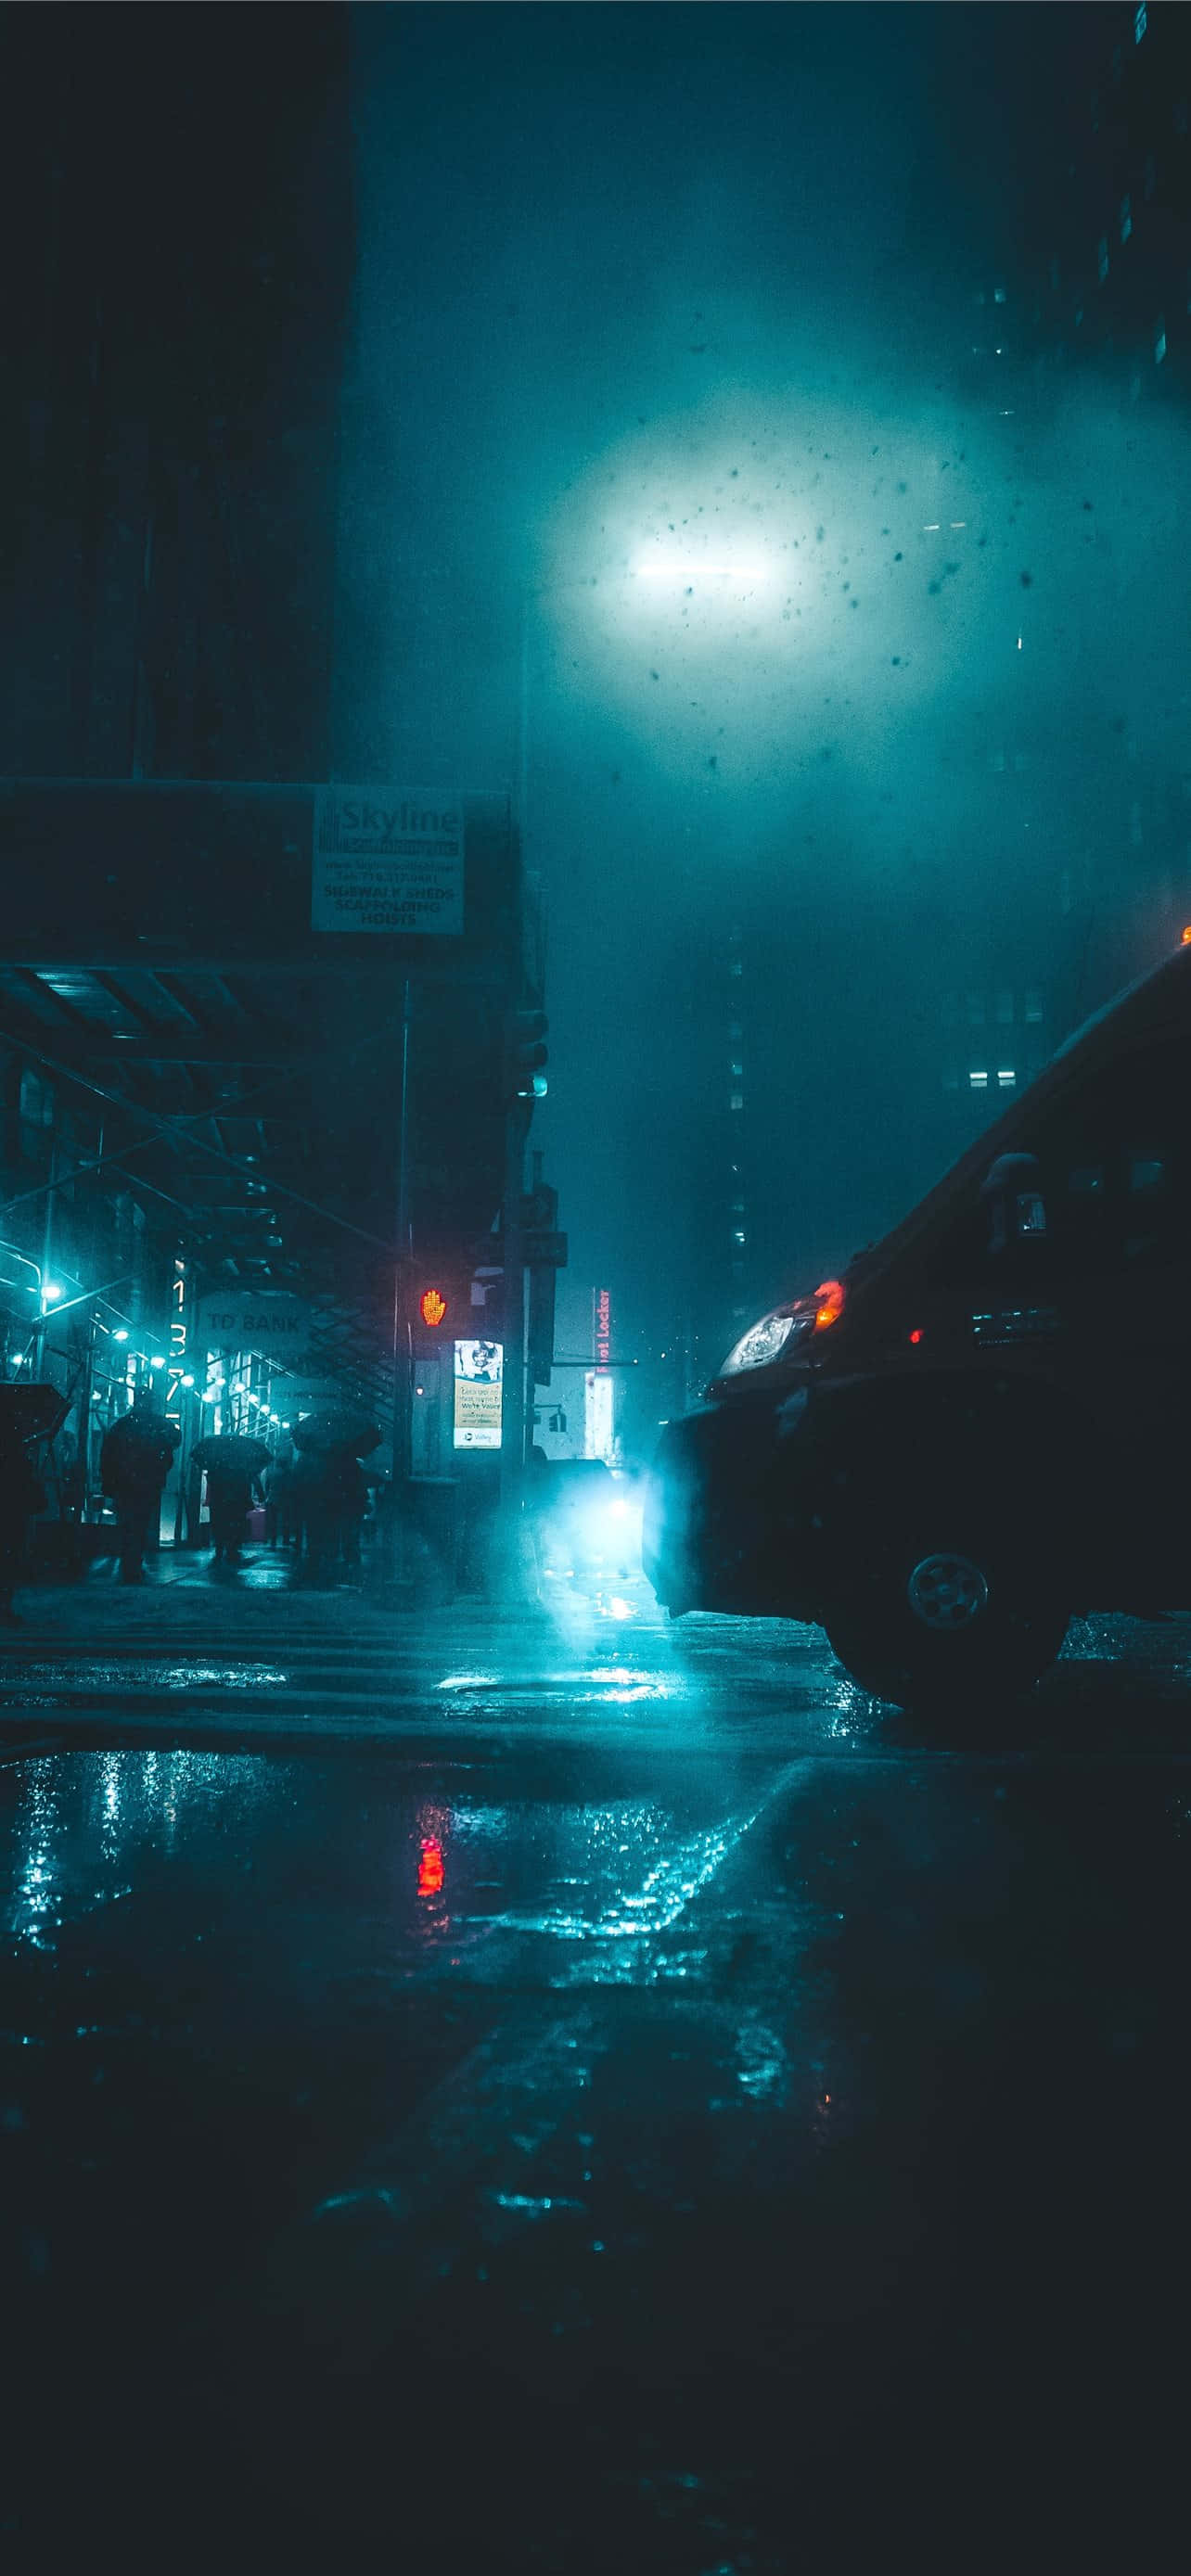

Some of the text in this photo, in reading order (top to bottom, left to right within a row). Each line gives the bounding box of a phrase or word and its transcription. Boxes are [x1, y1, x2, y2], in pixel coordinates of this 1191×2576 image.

[340, 801, 462, 842] Skyline
[324, 886, 455, 900] SIDEWALK SHEDS
[360, 913, 416, 925] HOISTS
[207, 1313, 298, 1333] TD BANK
[596, 1291, 609, 1338] Locker
